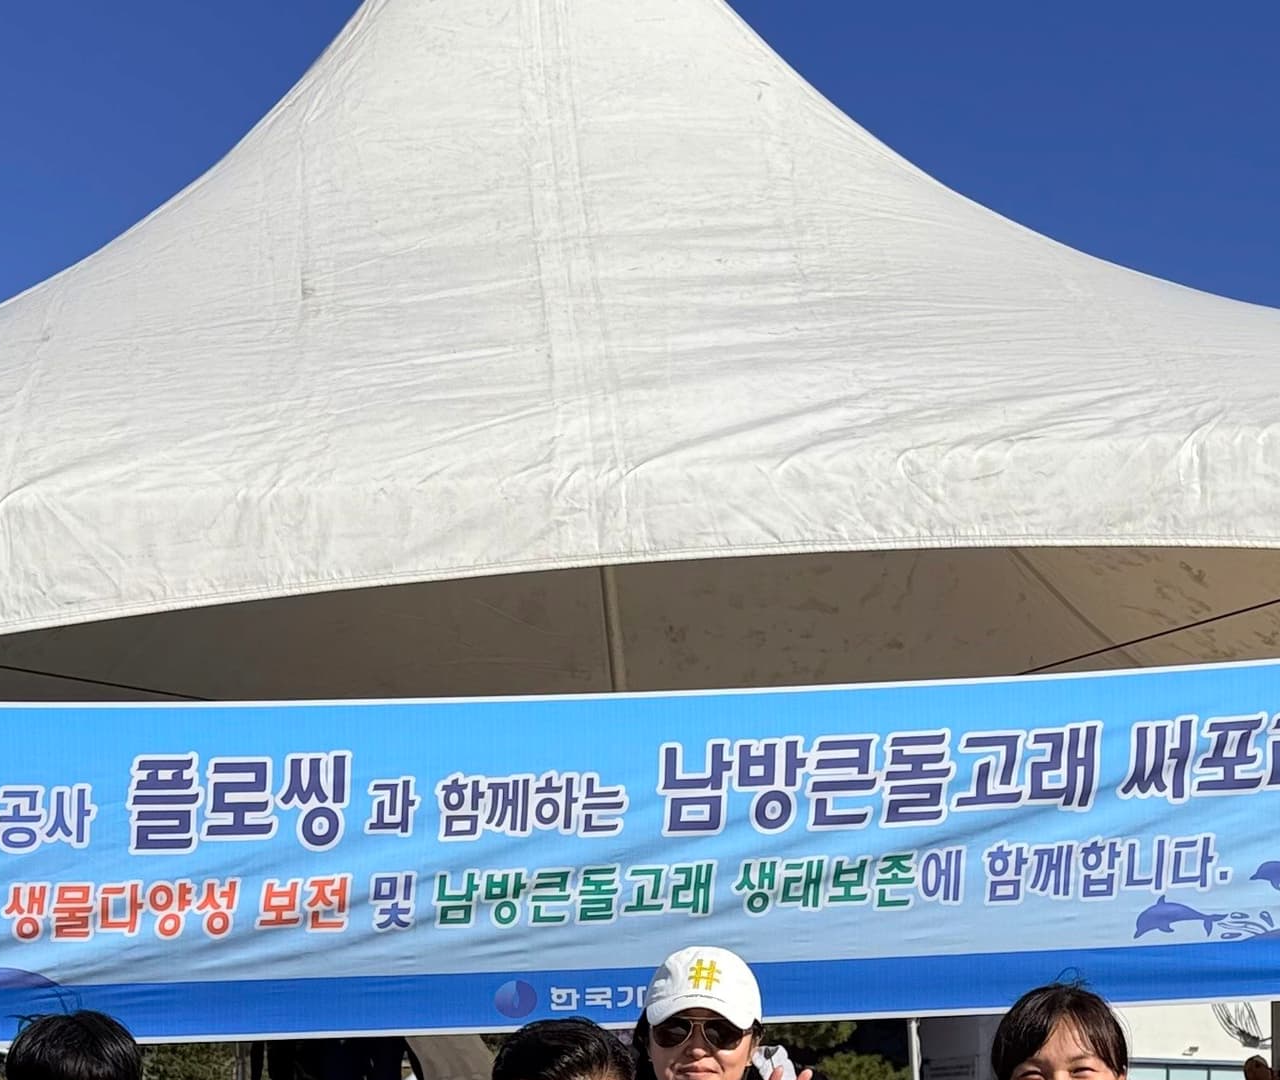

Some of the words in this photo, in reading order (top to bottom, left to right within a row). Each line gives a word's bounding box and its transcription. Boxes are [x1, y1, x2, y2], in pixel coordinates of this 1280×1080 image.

[131, 754, 347, 852] 플로씽
[368, 779, 417, 834] 과
[440, 775, 625, 838] 함께하는
[661, 724, 1097, 834] 남방큰돌고래
[4, 880, 237, 939] 생물다양성
[258, 877, 348, 930] 보전
[371, 875, 414, 930] 및
[435, 862, 715, 926] 남방큰돌고래
[734, 850, 963, 914] 생태보존에
[986, 836, 1230, 902] 함께합니다.
[549, 985, 648, 1011] 한국가
